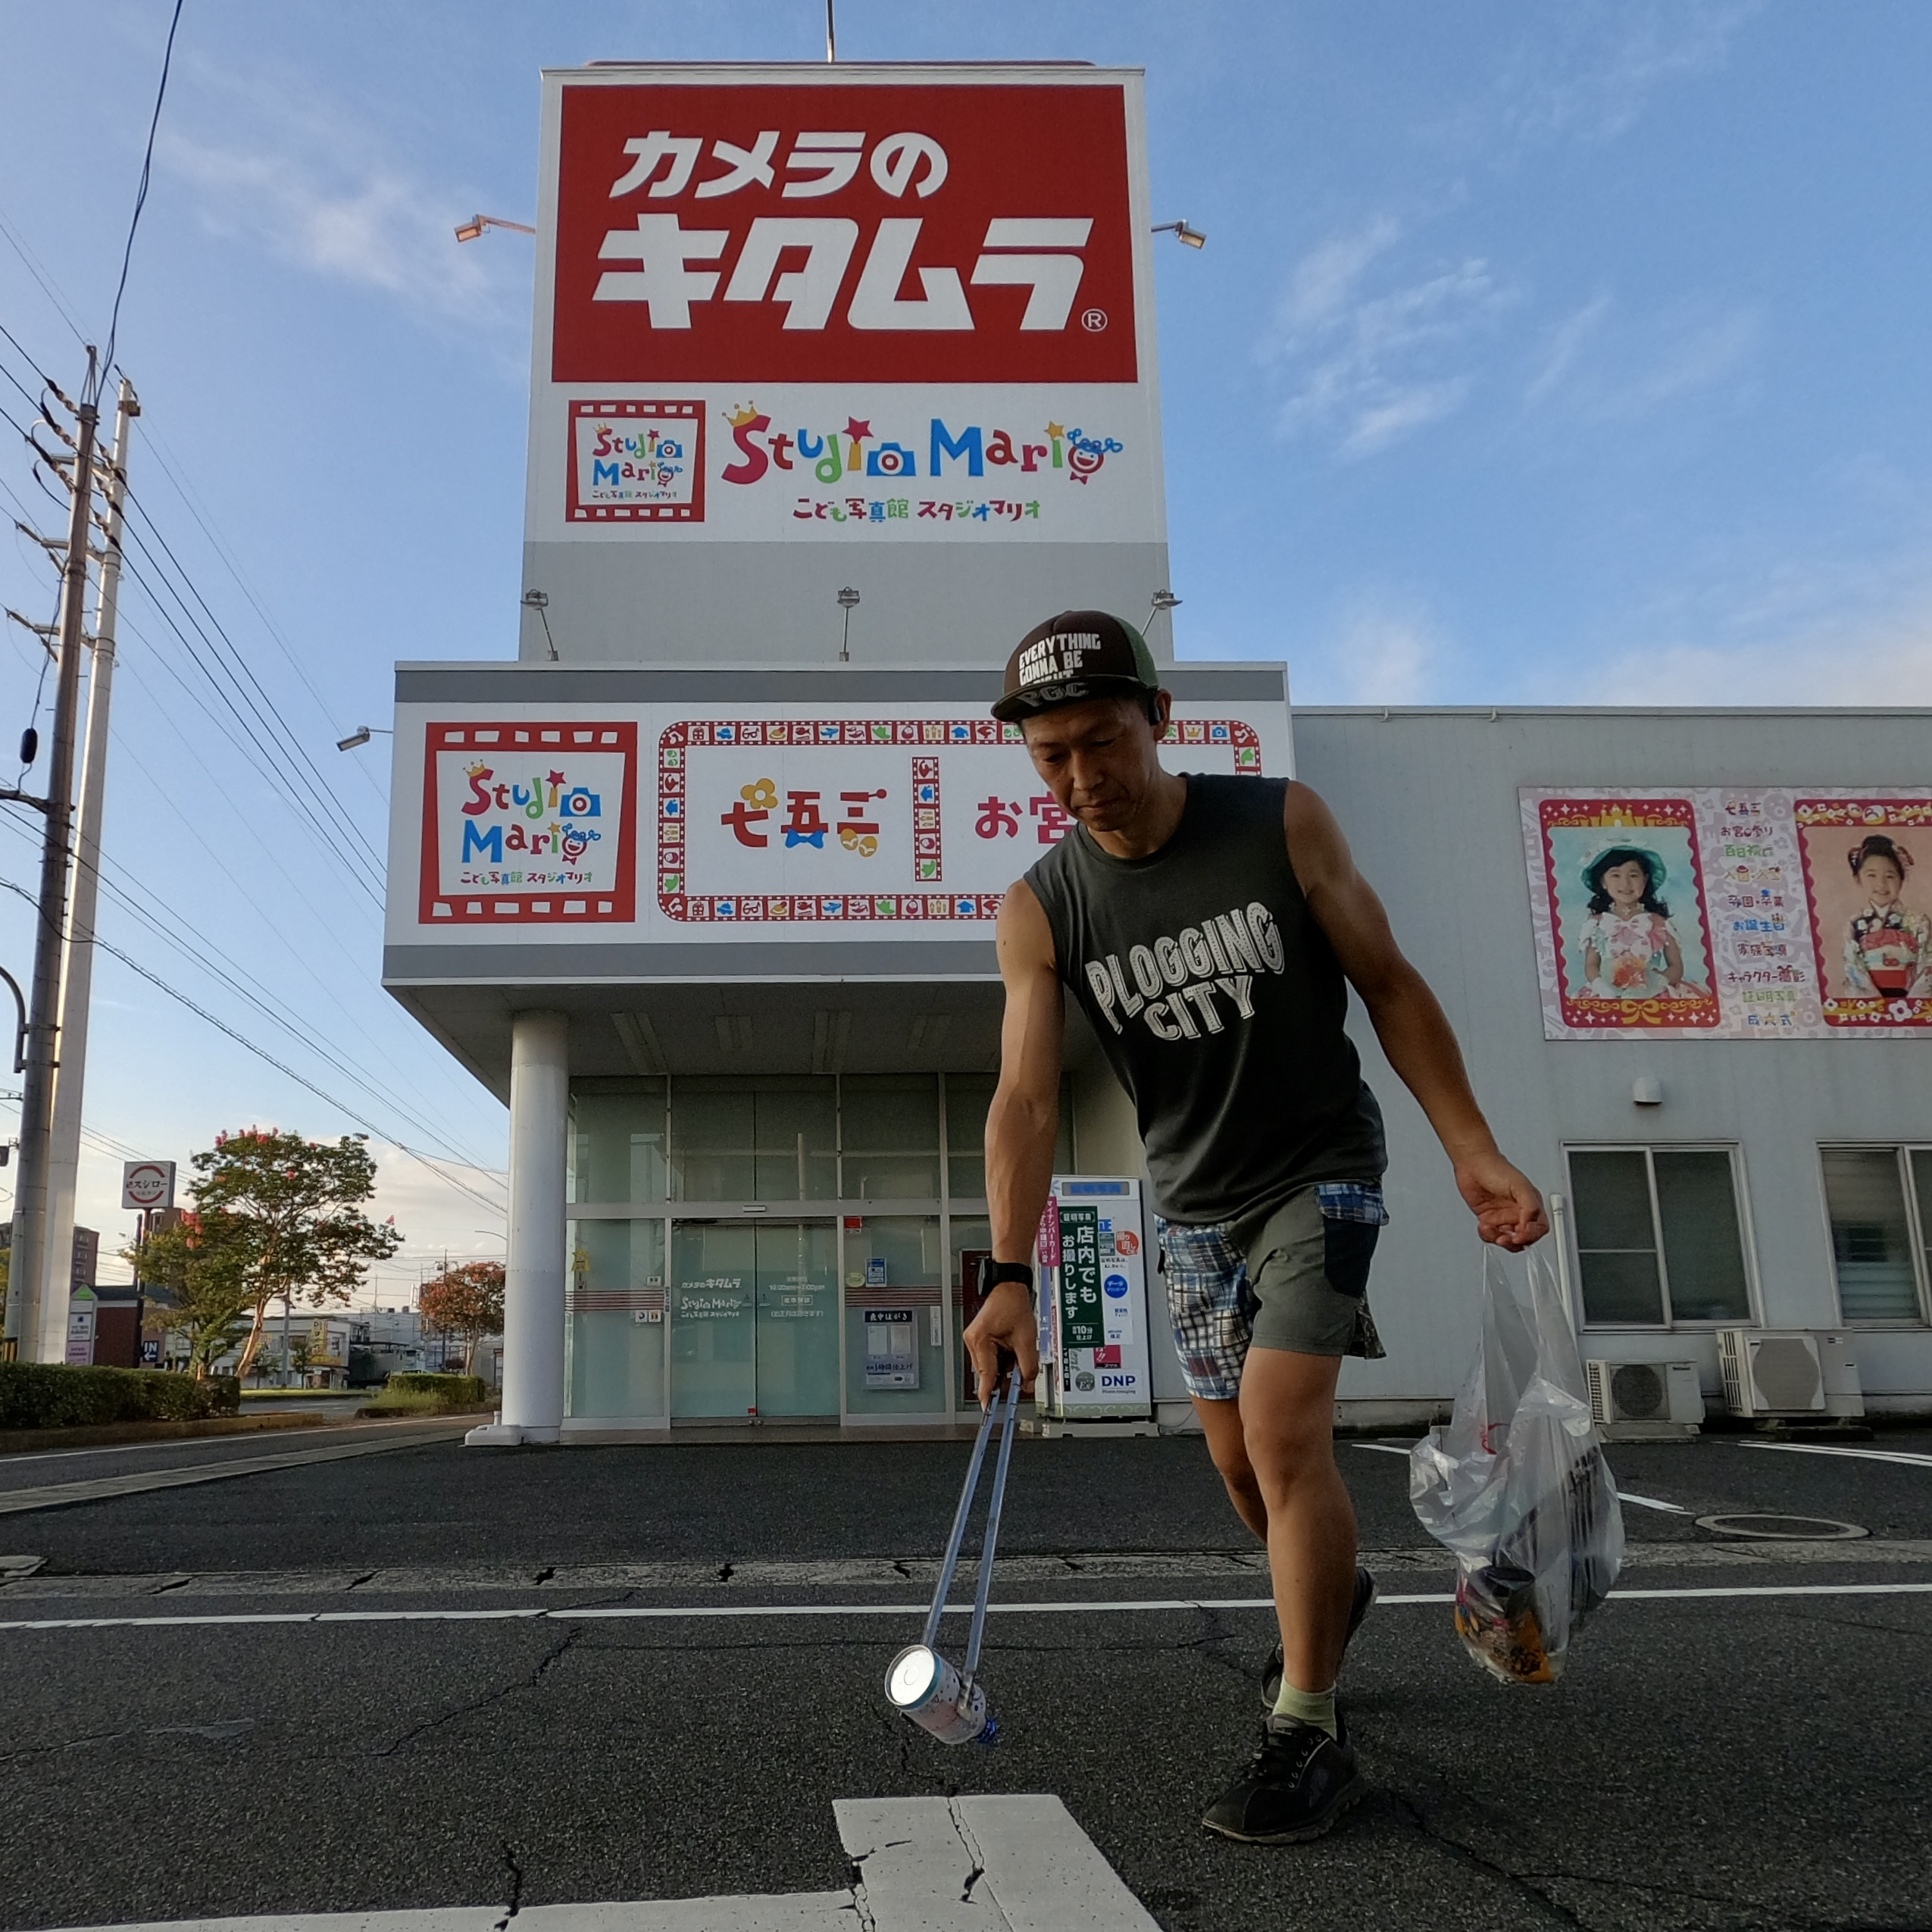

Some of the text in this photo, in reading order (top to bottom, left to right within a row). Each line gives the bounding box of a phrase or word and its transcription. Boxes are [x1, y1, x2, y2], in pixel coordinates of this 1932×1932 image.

[609, 131, 949, 199] カメラの
[592, 213, 1094, 330] キタムラ
[930, 418, 1117, 485] Mario
[792, 497, 1041, 523] こども写真館 スタジオマリオ
[1019, 633, 1102, 669] EVERYTHING
[1019, 655, 1058, 687] GONNA
[1063, 650, 1083, 670] BE
[461, 820, 599, 865] Mario
[721, 790, 883, 849] 七五三
[460, 871, 593, 886] こども写真館 スタジオマリオ
[1084, 902, 1285, 1035] PLOGGING
[1143, 974, 1255, 1041] CITY
[1061, 1235, 1078, 1319] お撮りします
[1076, 1225, 1097, 1303] 店内でも
[144, 1342, 158, 1352] IN
[1102, 1375, 1136, 1386] DNP
